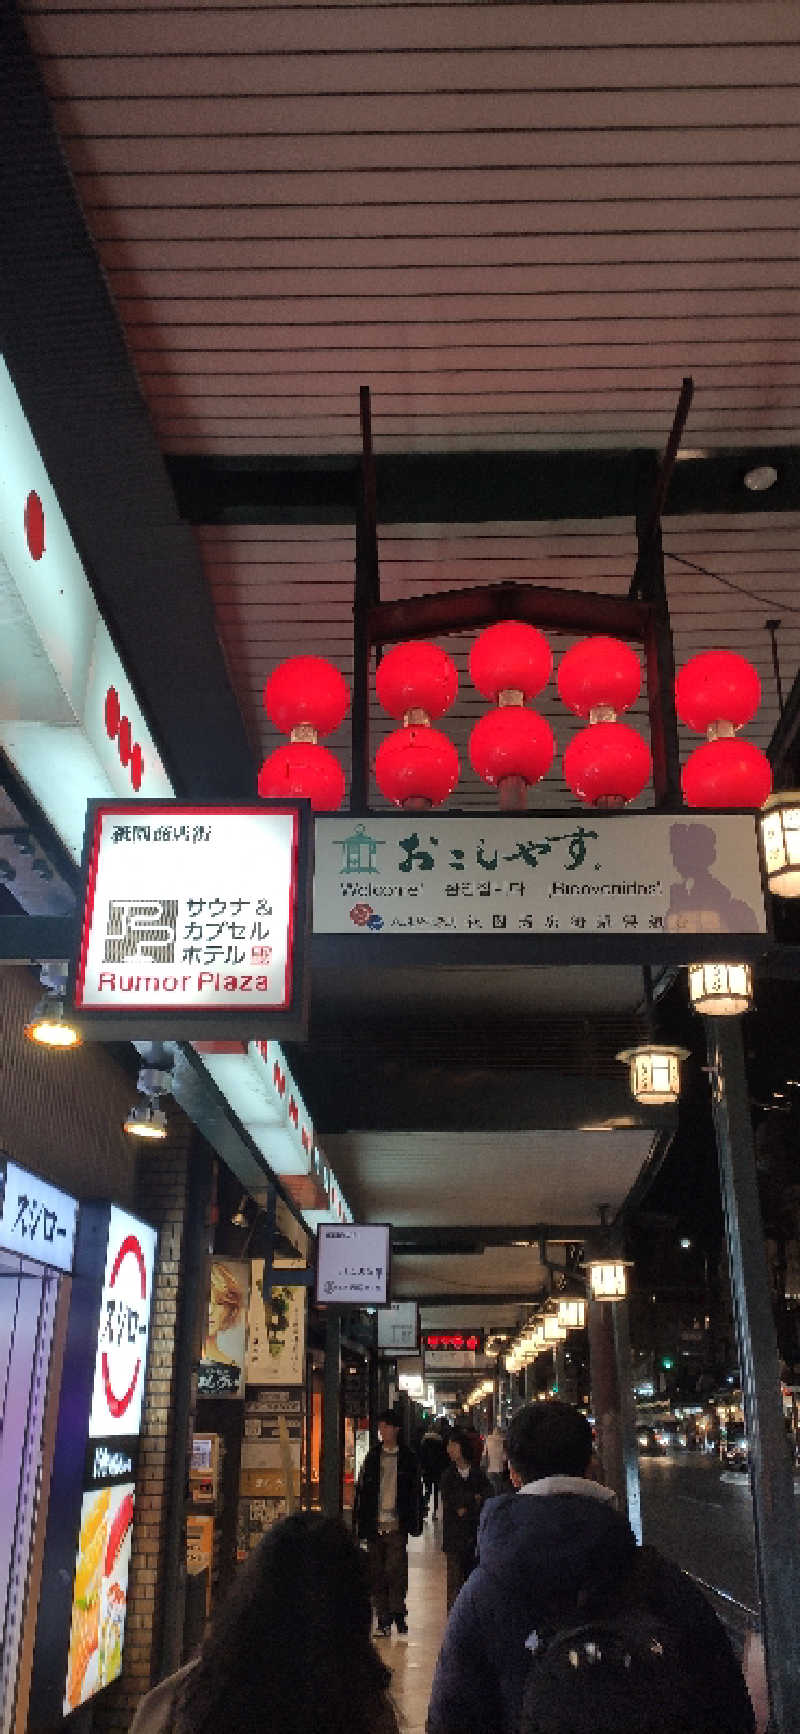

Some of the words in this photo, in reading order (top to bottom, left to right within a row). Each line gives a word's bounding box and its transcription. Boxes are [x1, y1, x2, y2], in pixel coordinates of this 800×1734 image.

[182, 945, 247, 966] ホテル
[97, 971, 192, 992] Rumor
[197, 971, 269, 992] Plaza
